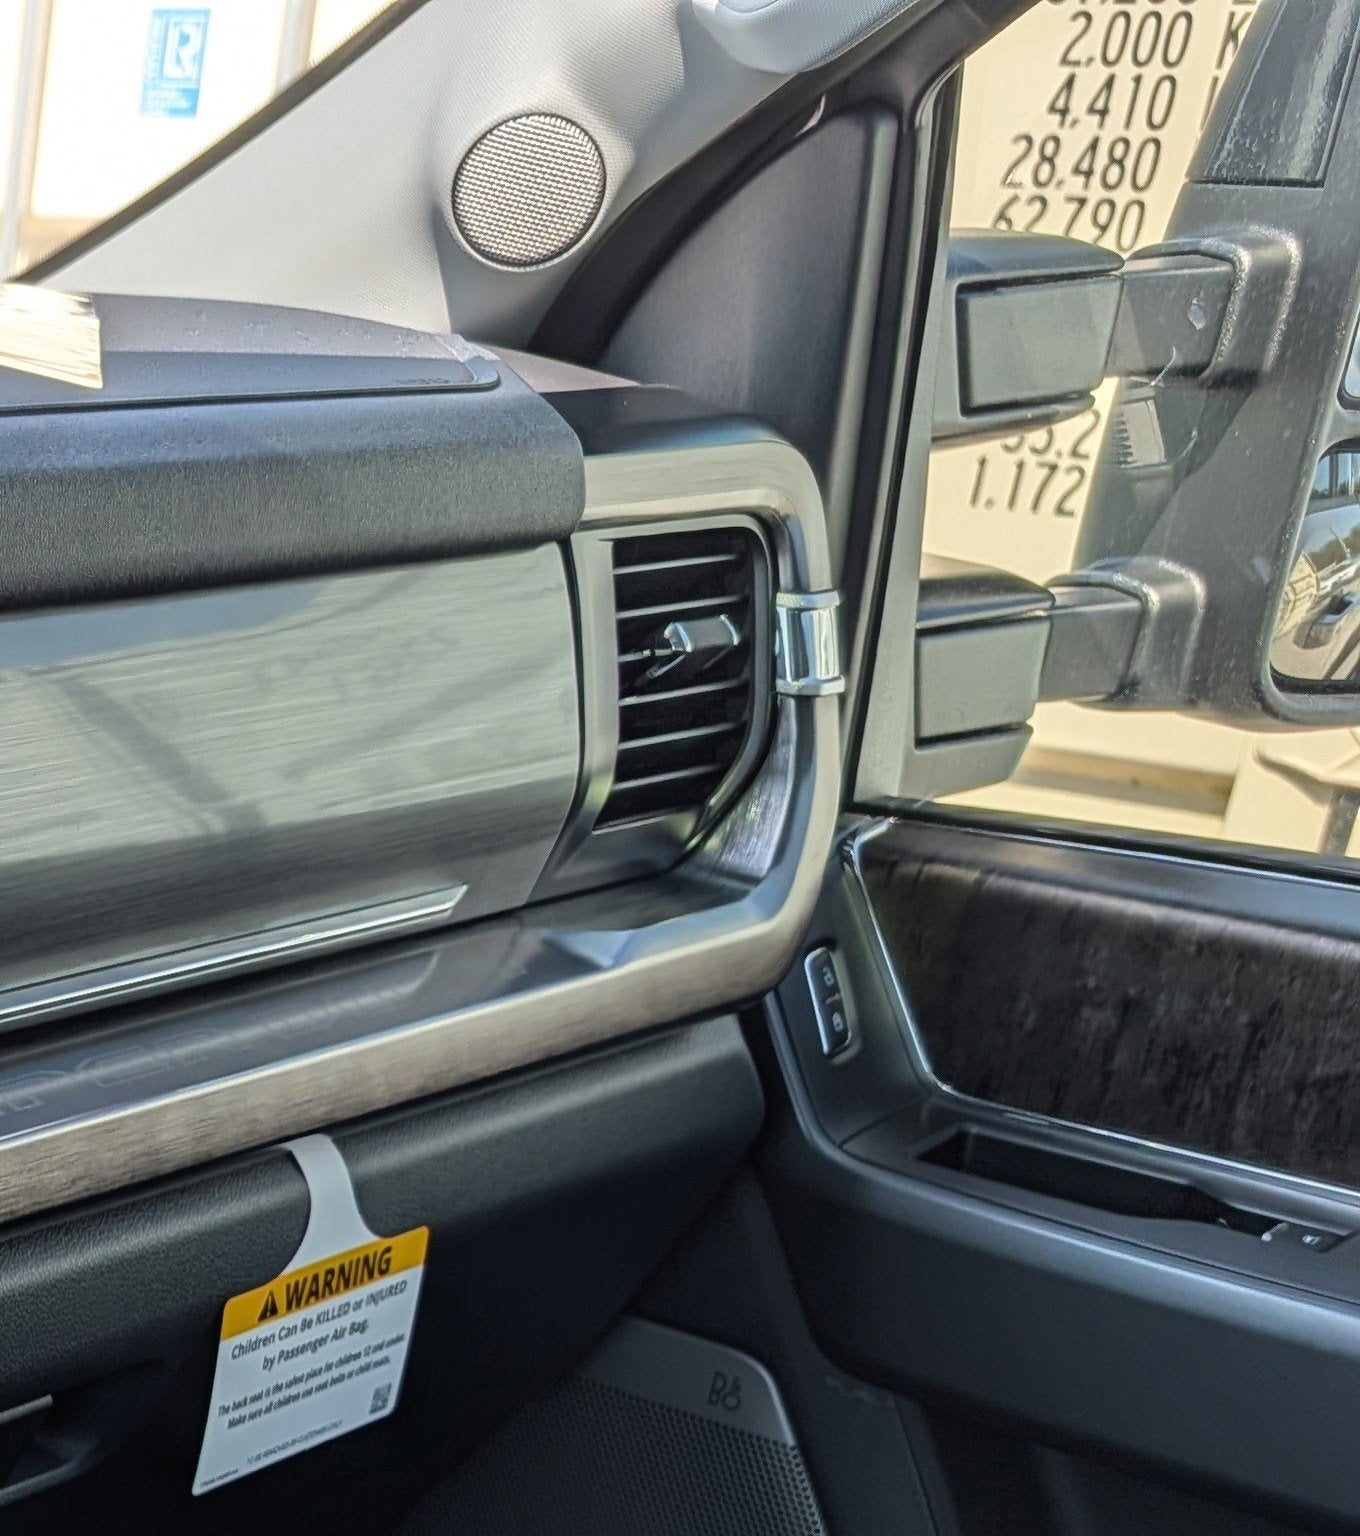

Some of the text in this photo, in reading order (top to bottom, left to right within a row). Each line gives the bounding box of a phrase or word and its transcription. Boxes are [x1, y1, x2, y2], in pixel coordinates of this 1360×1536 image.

[1059, 10, 1193, 68] 2.000
[1048, 75, 1177, 131] 4.410
[1002, 134, 1163, 193] 28.480
[969, 454, 1086, 517] 1.172
[284, 1245, 393, 1313] WARNING
[231, 1331, 276, 1360] Children
[277, 1323, 298, 1340] Can
[300, 1317, 314, 1331] Be
[315, 1301, 351, 1326] KILLED
[262, 1354, 276, 1371] by
[277, 1333, 329, 1365] Passenger
[330, 1325, 347, 1343] Air
